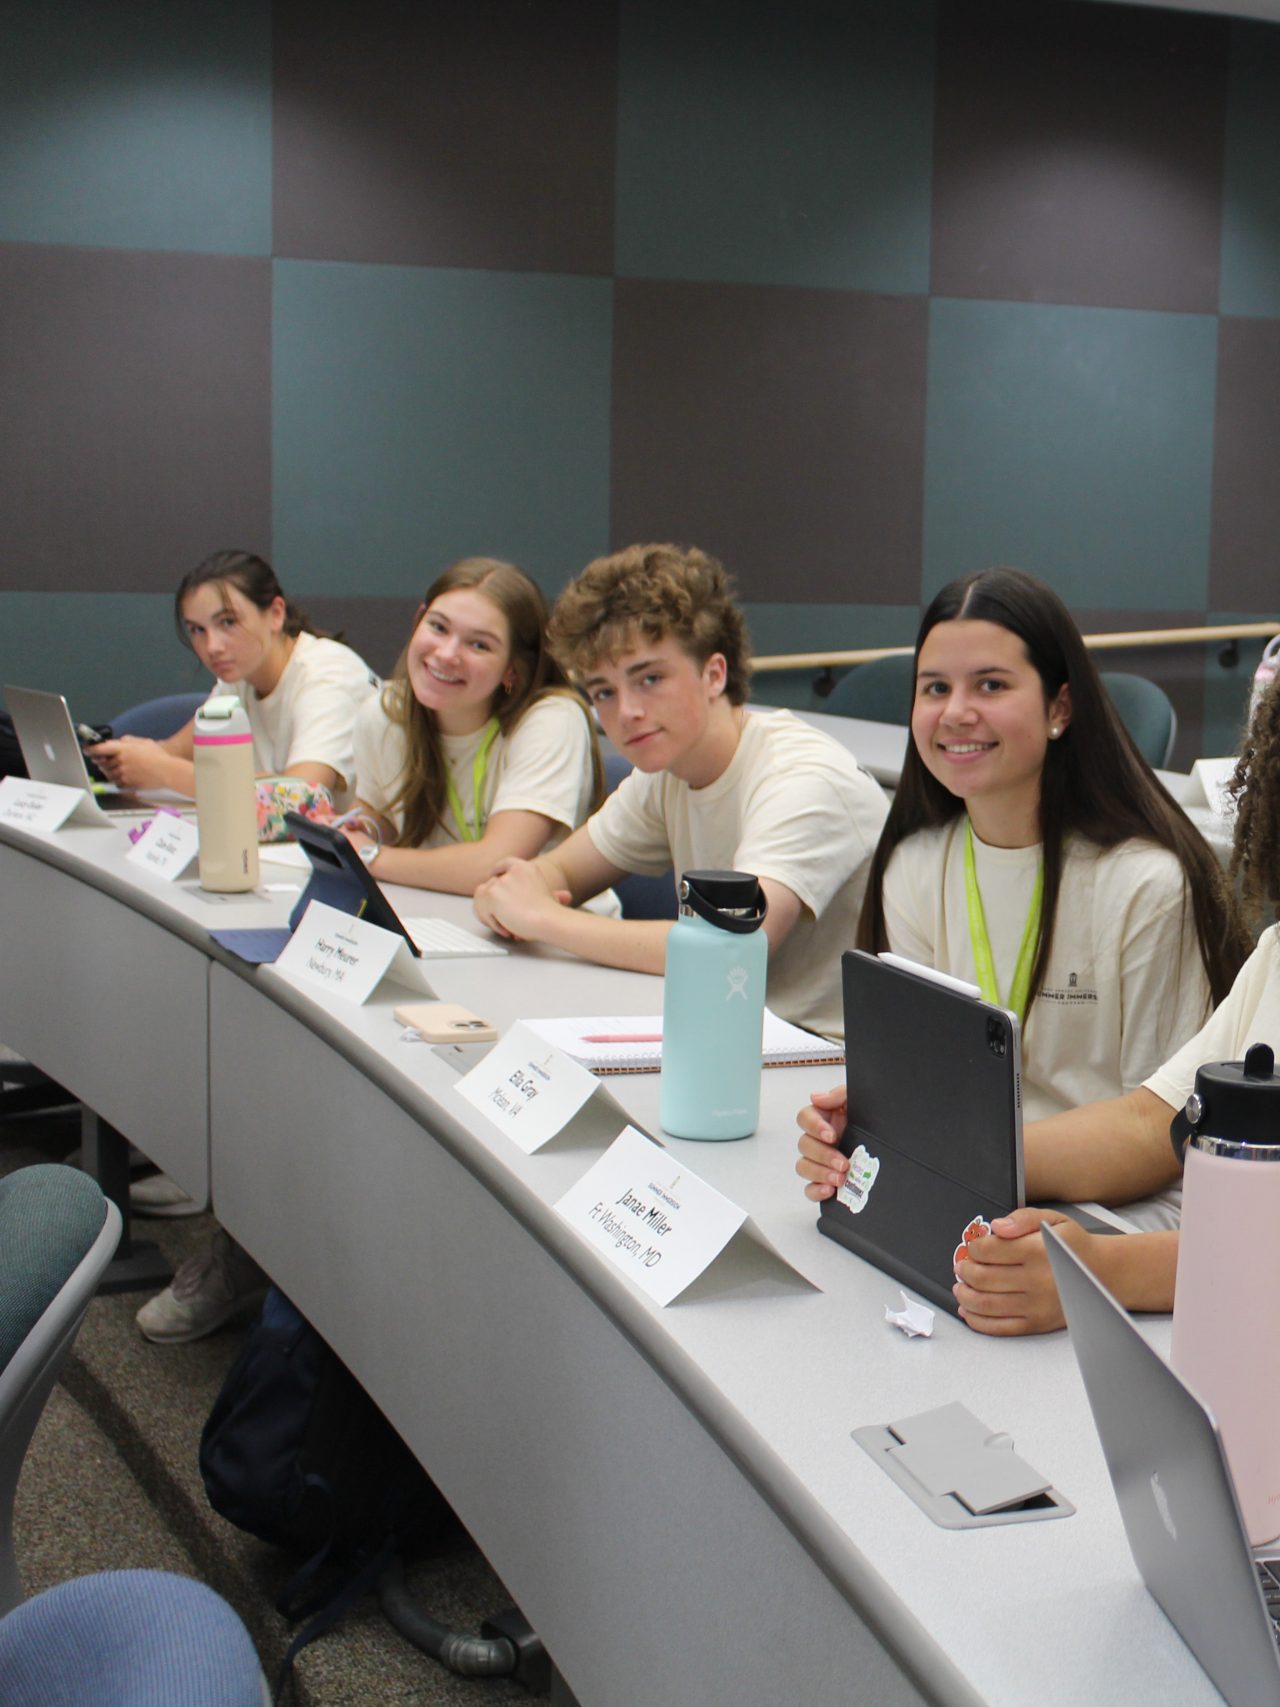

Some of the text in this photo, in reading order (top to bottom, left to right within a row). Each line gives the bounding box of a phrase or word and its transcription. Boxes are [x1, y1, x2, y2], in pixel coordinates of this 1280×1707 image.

[315, 938, 335, 957] Harry
[508, 1069, 525, 1089] Ella
[521, 1080, 539, 1102] Gray
[615, 1188, 673, 1237] Janae Miller
[599, 1208, 642, 1258] Washington,
[640, 1245, 663, 1268] MD
